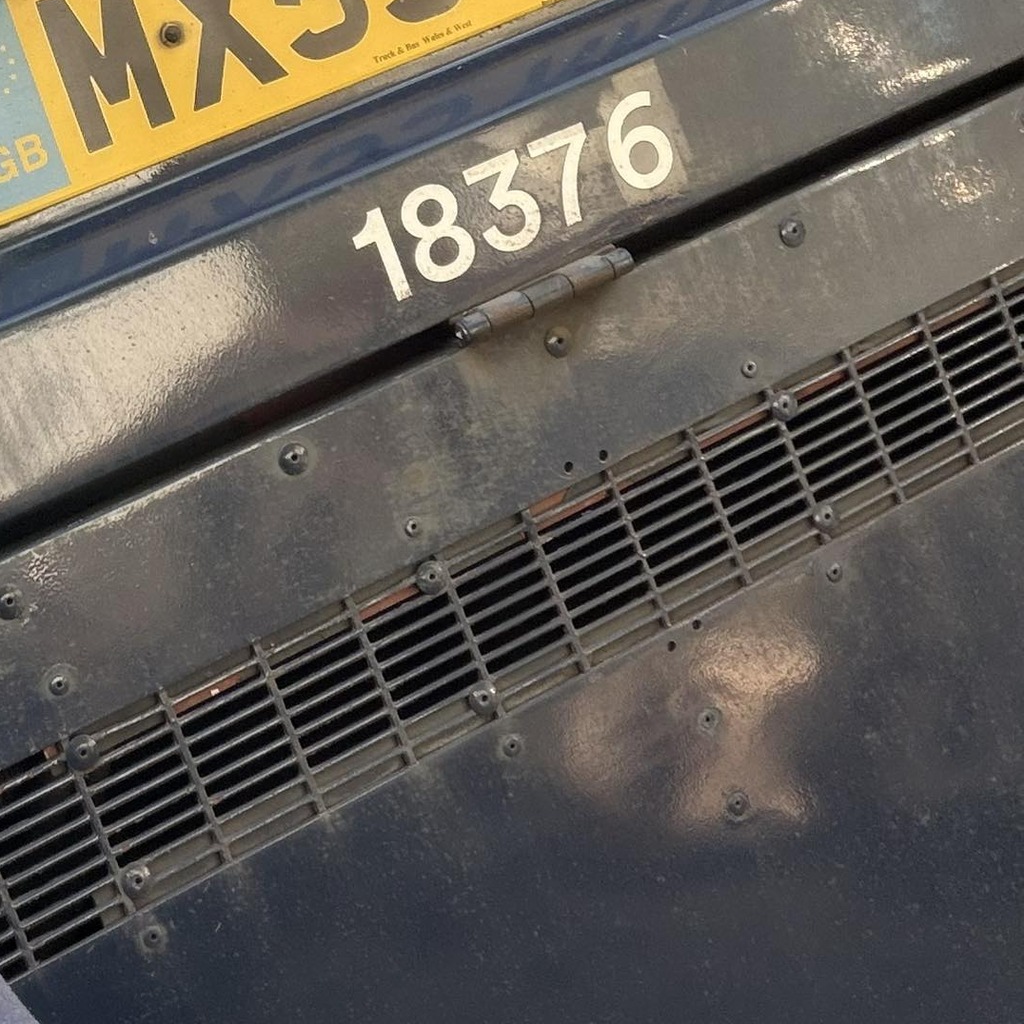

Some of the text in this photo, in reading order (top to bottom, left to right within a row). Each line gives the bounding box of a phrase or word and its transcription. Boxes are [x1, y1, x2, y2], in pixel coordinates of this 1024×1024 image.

[372, 50, 397, 64] Truck
[397, 46, 405, 55] &
[405, 41, 420, 52] Bus
[446, 26, 453, 36] &
[454, 19, 472, 32] West
[351, 90, 675, 303] 18376
